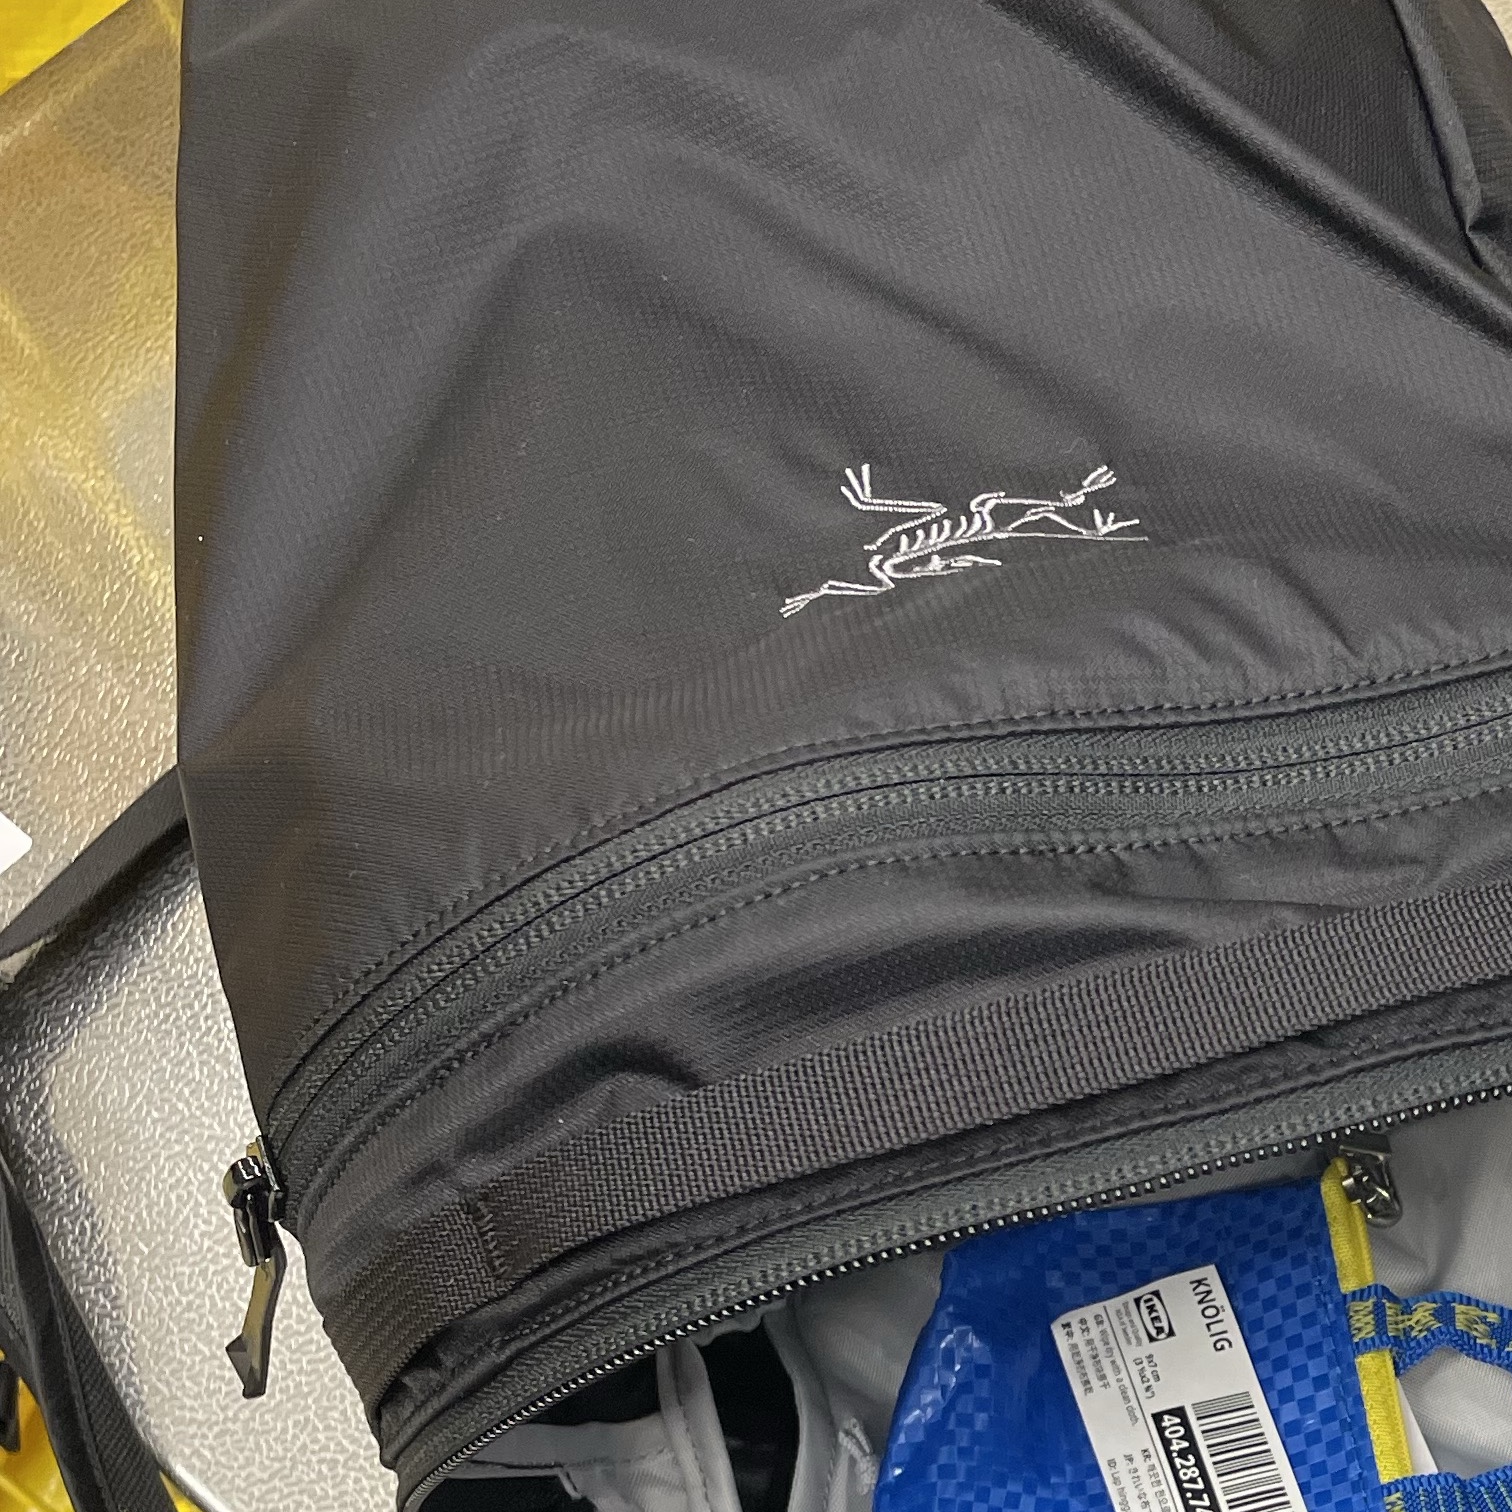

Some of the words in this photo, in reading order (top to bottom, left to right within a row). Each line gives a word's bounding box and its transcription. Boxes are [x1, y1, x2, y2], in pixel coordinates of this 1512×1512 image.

[1142, 1296, 1165, 1337] IKEA
[1188, 1276, 1233, 1352] KNÖLIG
[1144, 1352, 1158, 1368] 9x7
[1109, 1358, 1121, 1376] with
[1117, 1383, 1131, 1405] clean
[1150, 1369, 1161, 1382] cm
[1122, 1453, 1134, 1465] JP:
[1140, 1447, 1152, 1462] KR:
[1106, 1457, 1117, 1470] ID:
[1110, 1470, 1122, 1486] Lap
